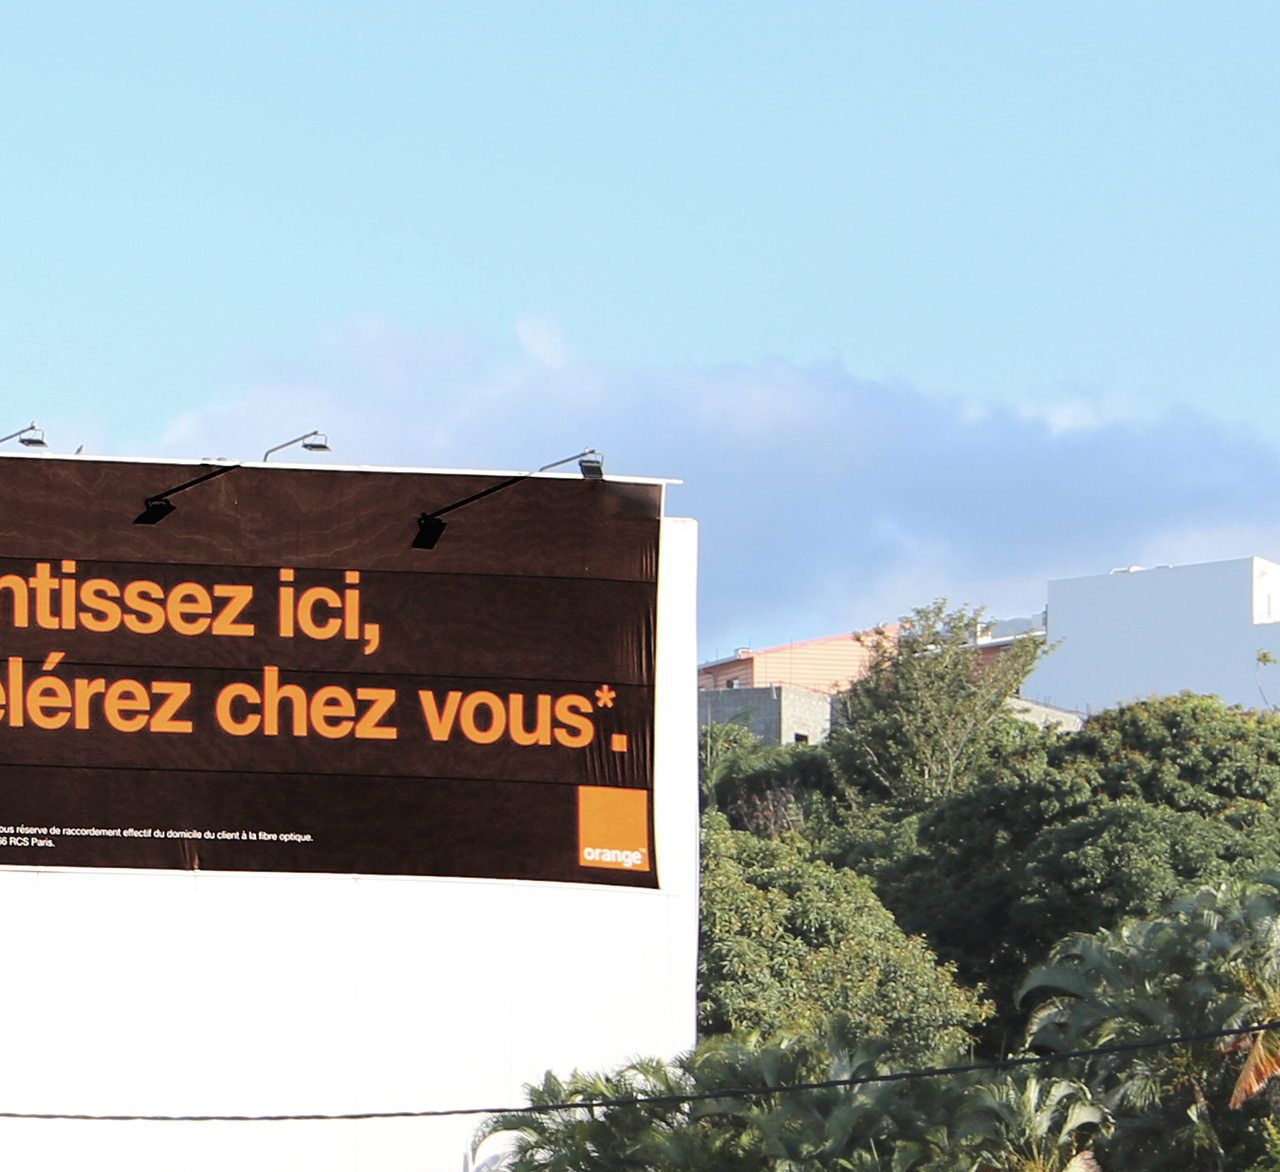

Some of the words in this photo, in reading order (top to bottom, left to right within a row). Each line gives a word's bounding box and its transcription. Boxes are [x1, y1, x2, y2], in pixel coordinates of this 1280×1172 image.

[278, 567, 380, 656] ici,
[215, 665, 398, 740] chez
[9, 836, 29, 847] RCS
[31, 836, 55, 848] Paris.
[50, 825, 61, 836] de
[63, 826, 121, 838] raccordement
[123, 827, 152, 838] effectif
[153, 828, 165, 839] du
[166, 828, 202, 839] domicile
[204, 829, 215, 840] du
[217, 830, 239, 840] client
[241, 829, 247, 841] à
[249, 830, 257, 841] la
[258, 830, 278, 841] fibre
[279, 832, 314, 843] optique.
[583, 847, 643, 868] orange
